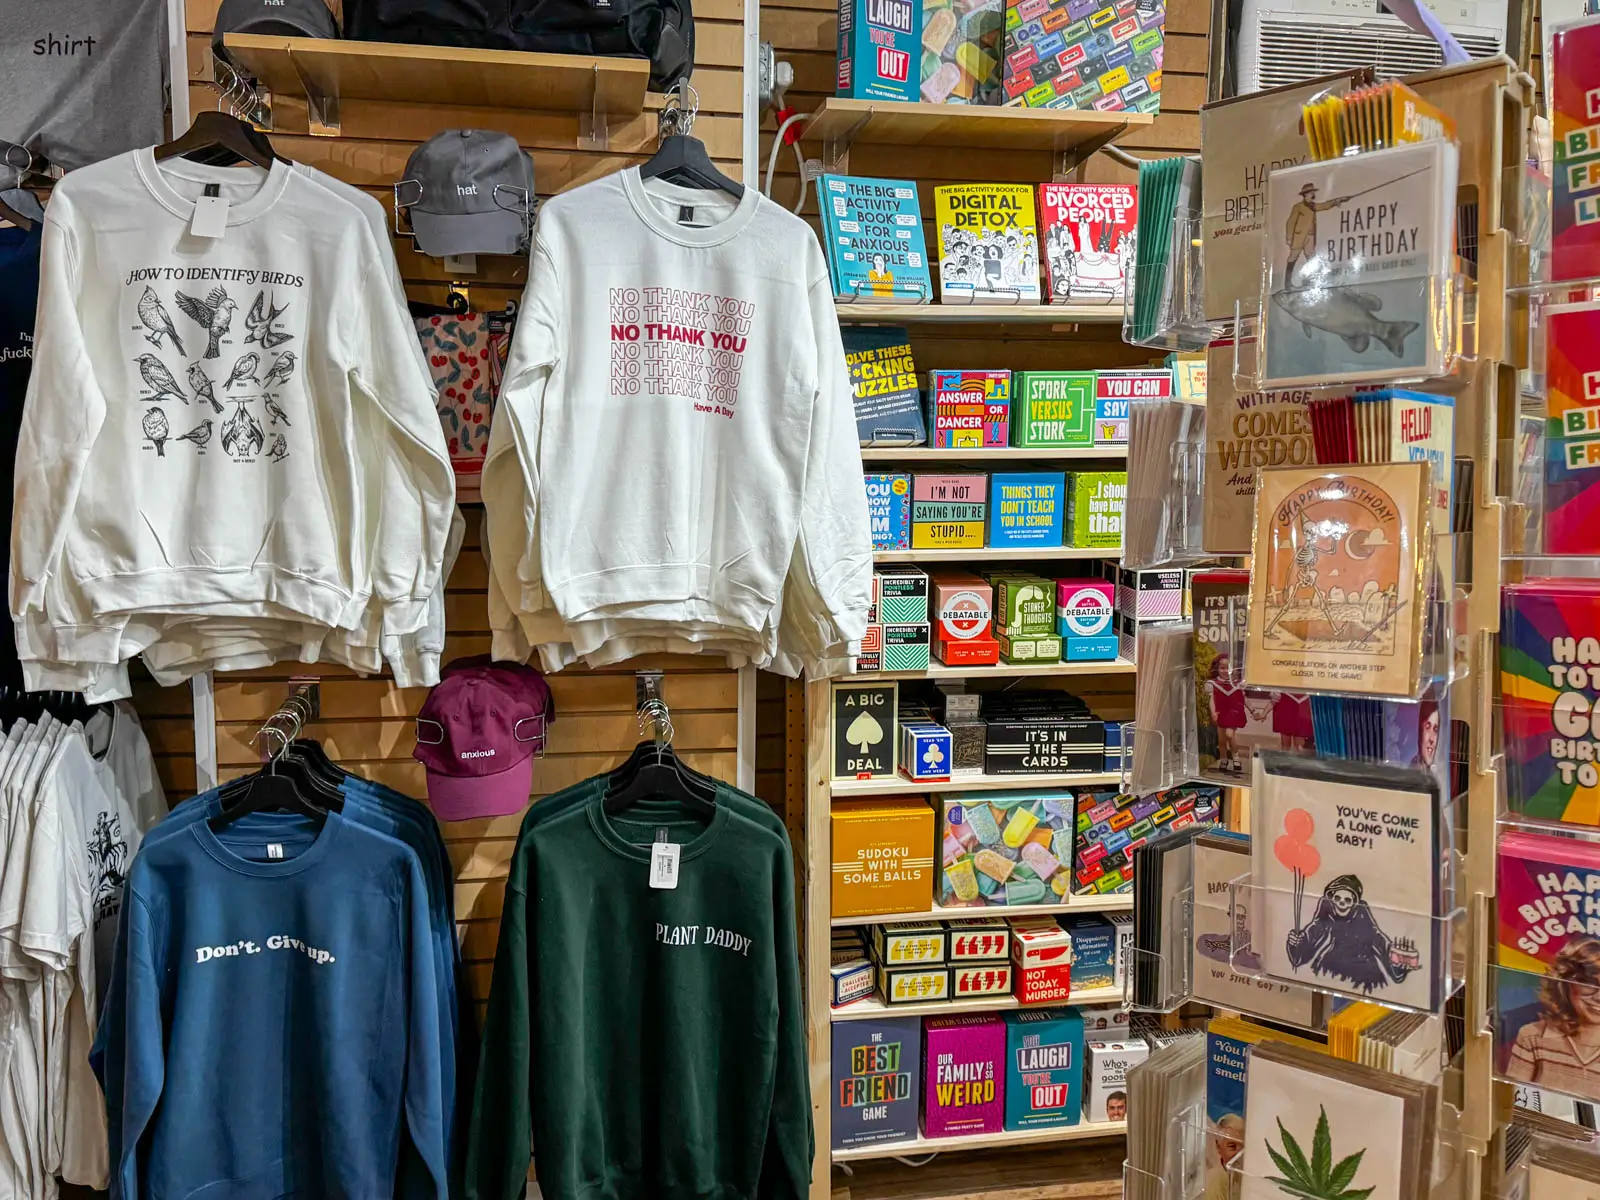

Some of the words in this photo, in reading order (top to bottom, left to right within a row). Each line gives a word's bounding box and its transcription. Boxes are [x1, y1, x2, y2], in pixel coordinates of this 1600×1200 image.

[868, 0, 910, 30] LAUGH
[33, 32, 96, 57] shirt
[881, 50, 904, 78] OUT
[840, 62, 849, 83] OUT
[457, 184, 478, 196] hat
[849, 184, 872, 197] THE
[875, 186, 896, 198] BIG
[846, 198, 901, 211] ACTIVITY
[950, 195, 1022, 210] DIGITAL
[1046, 192, 1134, 208] DIVORCED
[857, 212, 895, 224] BOOK
[955, 212, 1018, 227] DETOX
[1058, 207, 1126, 224] PEOPLE
[1340, 201, 1398, 234] HAPPY
[864, 226, 890, 237] FOR
[851, 238, 909, 252] ANXIOUS
[1327, 227, 1419, 263] BIRTHDAY
[126, 268, 162, 285] HOW
[162, 268, 184, 279] TO
[187, 268, 258, 285] IDENTIFY
[261, 272, 304, 287] BIRDS
[609, 288, 640, 305] NO
[643, 287, 711, 312] THANK
[714, 296, 755, 319] YOU
[610, 306, 640, 323] NO
[643, 306, 708, 329] THANK
[712, 314, 751, 336] YOU
[611, 324, 640, 341] NO
[644, 324, 706, 347] THANK
[711, 332, 747, 353] YOU
[611, 342, 640, 359] NO
[644, 342, 704, 364] THANK
[708, 349, 743, 371] YOU
[876, 344, 912, 359] THESE
[611, 360, 640, 377] NO
[644, 360, 703, 381] THANK
[706, 367, 740, 388] YOU
[611, 378, 640, 395] NO
[644, 378, 701, 399] THANK
[704, 383, 738, 405] YOU
[1032, 380, 1068, 400] SPORK
[1107, 379, 1131, 396] YOU
[1133, 379, 1161, 396] CAN
[938, 392, 983, 403] ANSWER
[1237, 391, 1276, 410] WITH
[1280, 391, 1312, 405] AGE
[694, 402, 712, 413] Have
[714, 405, 721, 415] A
[722, 406, 734, 419] Day
[989, 406, 1003, 414] OR
[1031, 400, 1073, 420] VERSUS
[1103, 401, 1129, 417] SAY
[937, 416, 982, 428] DANCER
[1401, 406, 1432, 444] HELLO!
[1029, 421, 1065, 441] STORK
[1226, 472, 1253, 485] And
[930, 486, 946, 499] I'M
[952, 486, 970, 499] NOT
[1002, 486, 1032, 499] THINGS
[1034, 485, 1055, 498] THEY
[916, 506, 948, 519] SAYING
[951, 506, 982, 519] YOU'RE
[1001, 501, 1024, 514] DON'T
[1027, 500, 1055, 513] TEACH
[1090, 499, 1108, 513] have
[1001, 515, 1015, 527] YOU
[1016, 515, 1024, 526] IN
[1026, 515, 1053, 526] SCHOOL
[1023, 601, 1045, 613] STONER
[1066, 608, 1110, 616] DEBATABLE
[943, 611, 989, 619] DEBATABLE
[1024, 613, 1052, 624] THOUGHTS
[1272, 660, 1328, 669] CONGRATULATIONS
[1339, 663, 1367, 671] ANOTHER
[845, 695, 855, 706] A
[860, 694, 884, 706] BIG
[1025, 731, 1049, 742] IT'S
[1054, 731, 1067, 742] IN
[461, 747, 496, 759] anxious
[1034, 744, 1058, 754] THE
[847, 758, 882, 770] DEAL
[1022, 756, 1069, 767] CARDS
[1336, 805, 1378, 821] YOU'VE
[1381, 813, 1419, 828] COME
[1336, 819, 1345, 830] A
[1349, 820, 1382, 835] LONG
[1386, 827, 1415, 843] WAY,
[1336, 832, 1373, 849] BABY!
[857, 847, 909, 859] SUDOKU
[868, 860, 898, 870] WITH
[843, 873, 879, 884] SOME
[884, 870, 922, 881] BALLS
[655, 922, 699, 946] PLANT
[704, 926, 752, 957] DADDY
[1518, 915, 1600, 955] SUGAR
[195, 940, 261, 963] Don't.
[266, 935, 305, 952] Give
[307, 946, 336, 964] up.
[1026, 970, 1046, 981] NOT
[1211, 968, 1225, 978] YOU
[1257, 980, 1274, 991] GOT
[1026, 979, 1059, 991] TODAY.
[1026, 988, 1069, 1002] MURDER.
[871, 1033, 883, 1043] THE
[1023, 1034, 1040, 1048] YOU
[1215, 1040, 1240, 1056] You
[854, 1044, 899, 1074] BEST
[937, 1053, 953, 1064] OUR
[1021, 1046, 1067, 1070] LAUGH
[1102, 1059, 1128, 1069] Who's
[1213, 1054, 1245, 1069] when
[937, 1062, 984, 1083] FAMILY
[986, 1061, 993, 1070] IS
[985, 1070, 994, 1079] SO
[843, 1074, 909, 1105] FRIEND
[936, 1080, 995, 1107] WEIRD
[1035, 1086, 1063, 1107] OUT
[863, 1106, 888, 1120] GAME
